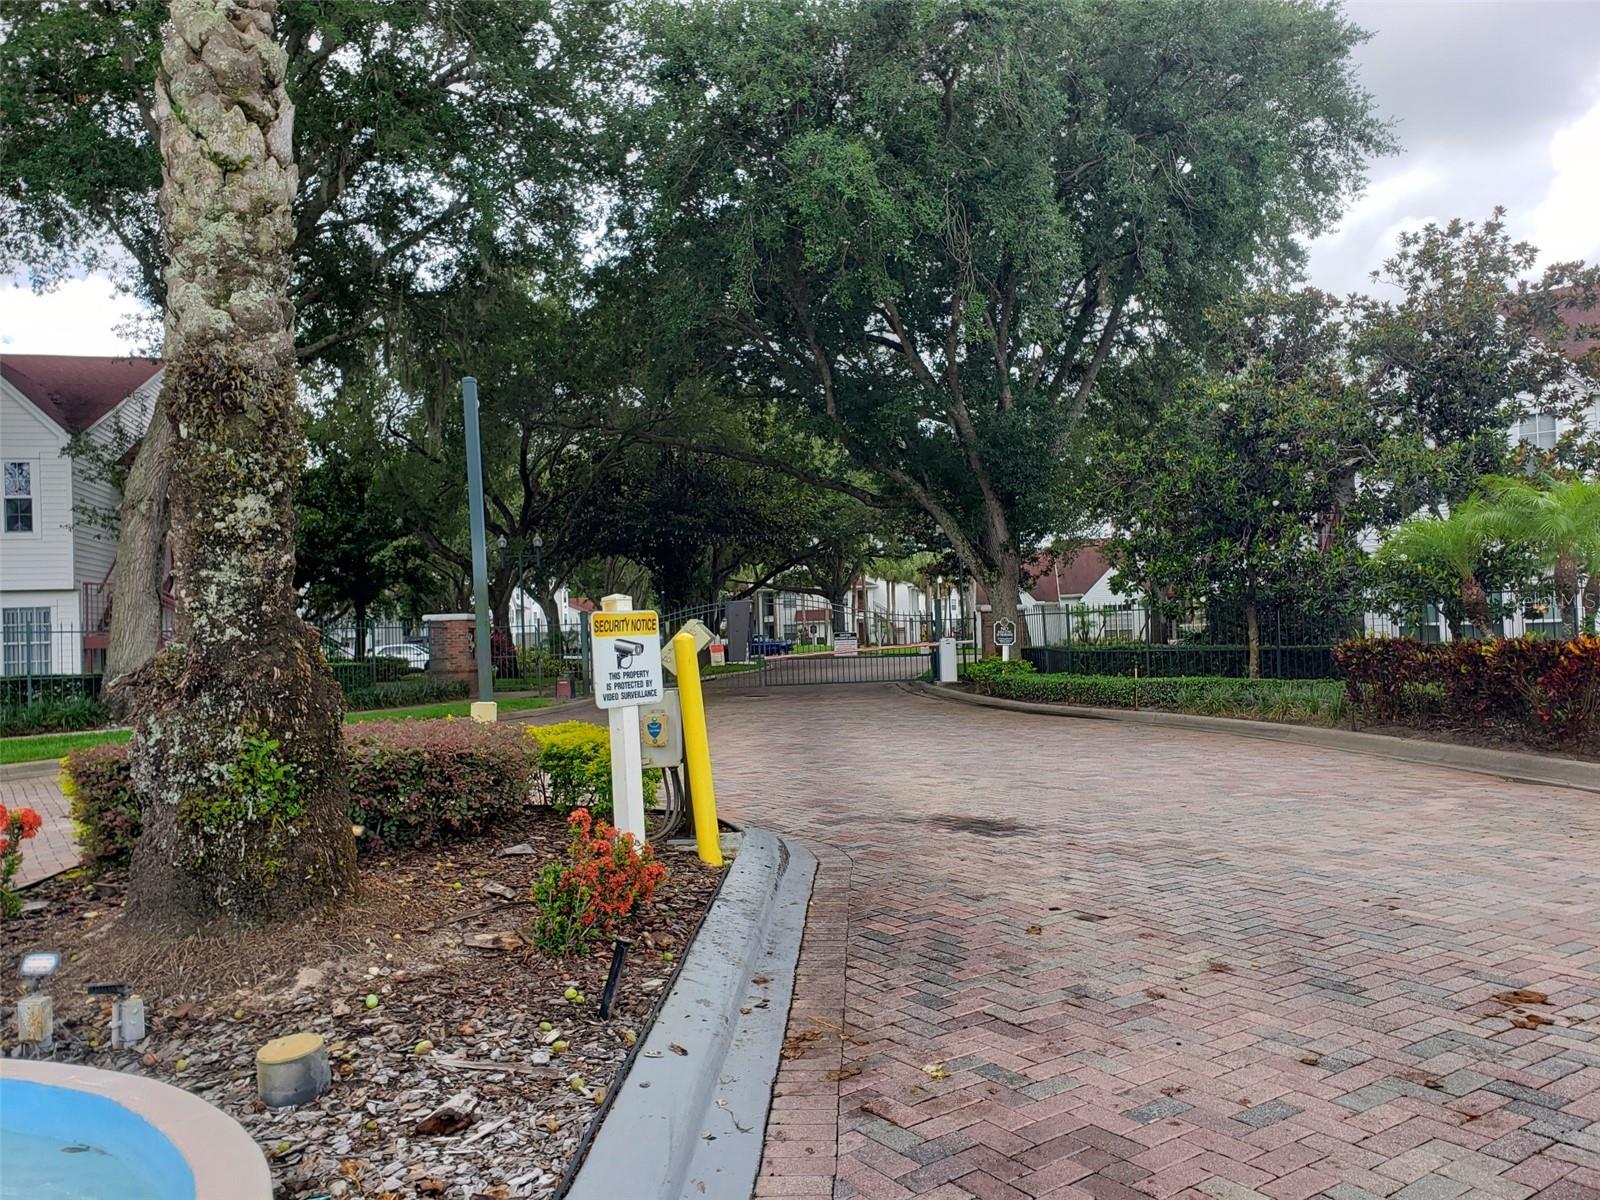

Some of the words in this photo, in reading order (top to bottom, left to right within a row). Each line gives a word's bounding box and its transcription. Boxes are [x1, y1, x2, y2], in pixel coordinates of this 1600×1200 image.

[594, 619, 630, 633] SECURITY
[631, 618, 656, 631] NOTICE
[609, 672, 621, 680] THIS
[623, 670, 649, 679] PROPERTY
[606, 683, 612, 691] IS
[614, 680, 644, 690] PROTECTED
[646, 680, 653, 688] BY
[603, 692, 619, 702] VIDEO
[621, 689, 658, 700] SURVEILLANCE
